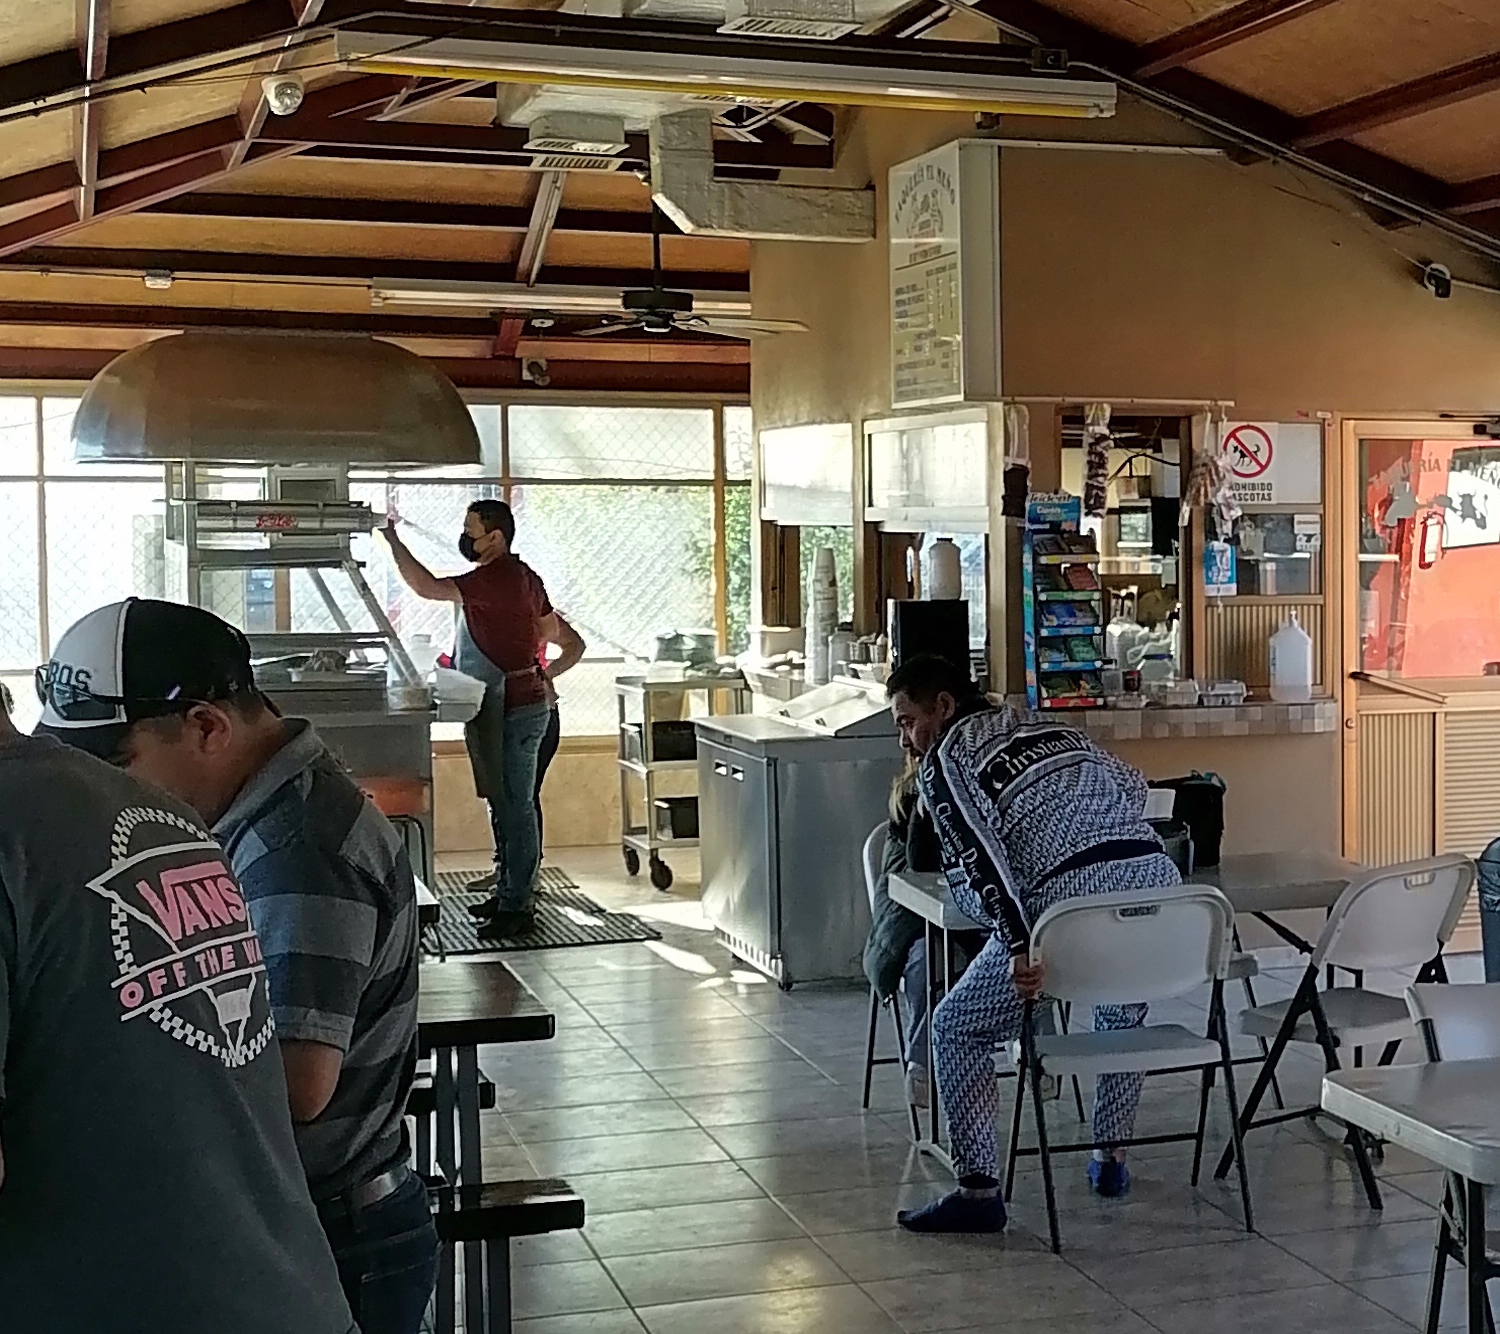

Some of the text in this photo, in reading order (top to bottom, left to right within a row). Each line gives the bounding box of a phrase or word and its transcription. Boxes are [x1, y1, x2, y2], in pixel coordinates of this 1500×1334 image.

[135, 860, 248, 942] VANS
[120, 962, 187, 1008] OFF
[194, 944, 236, 978] THE
